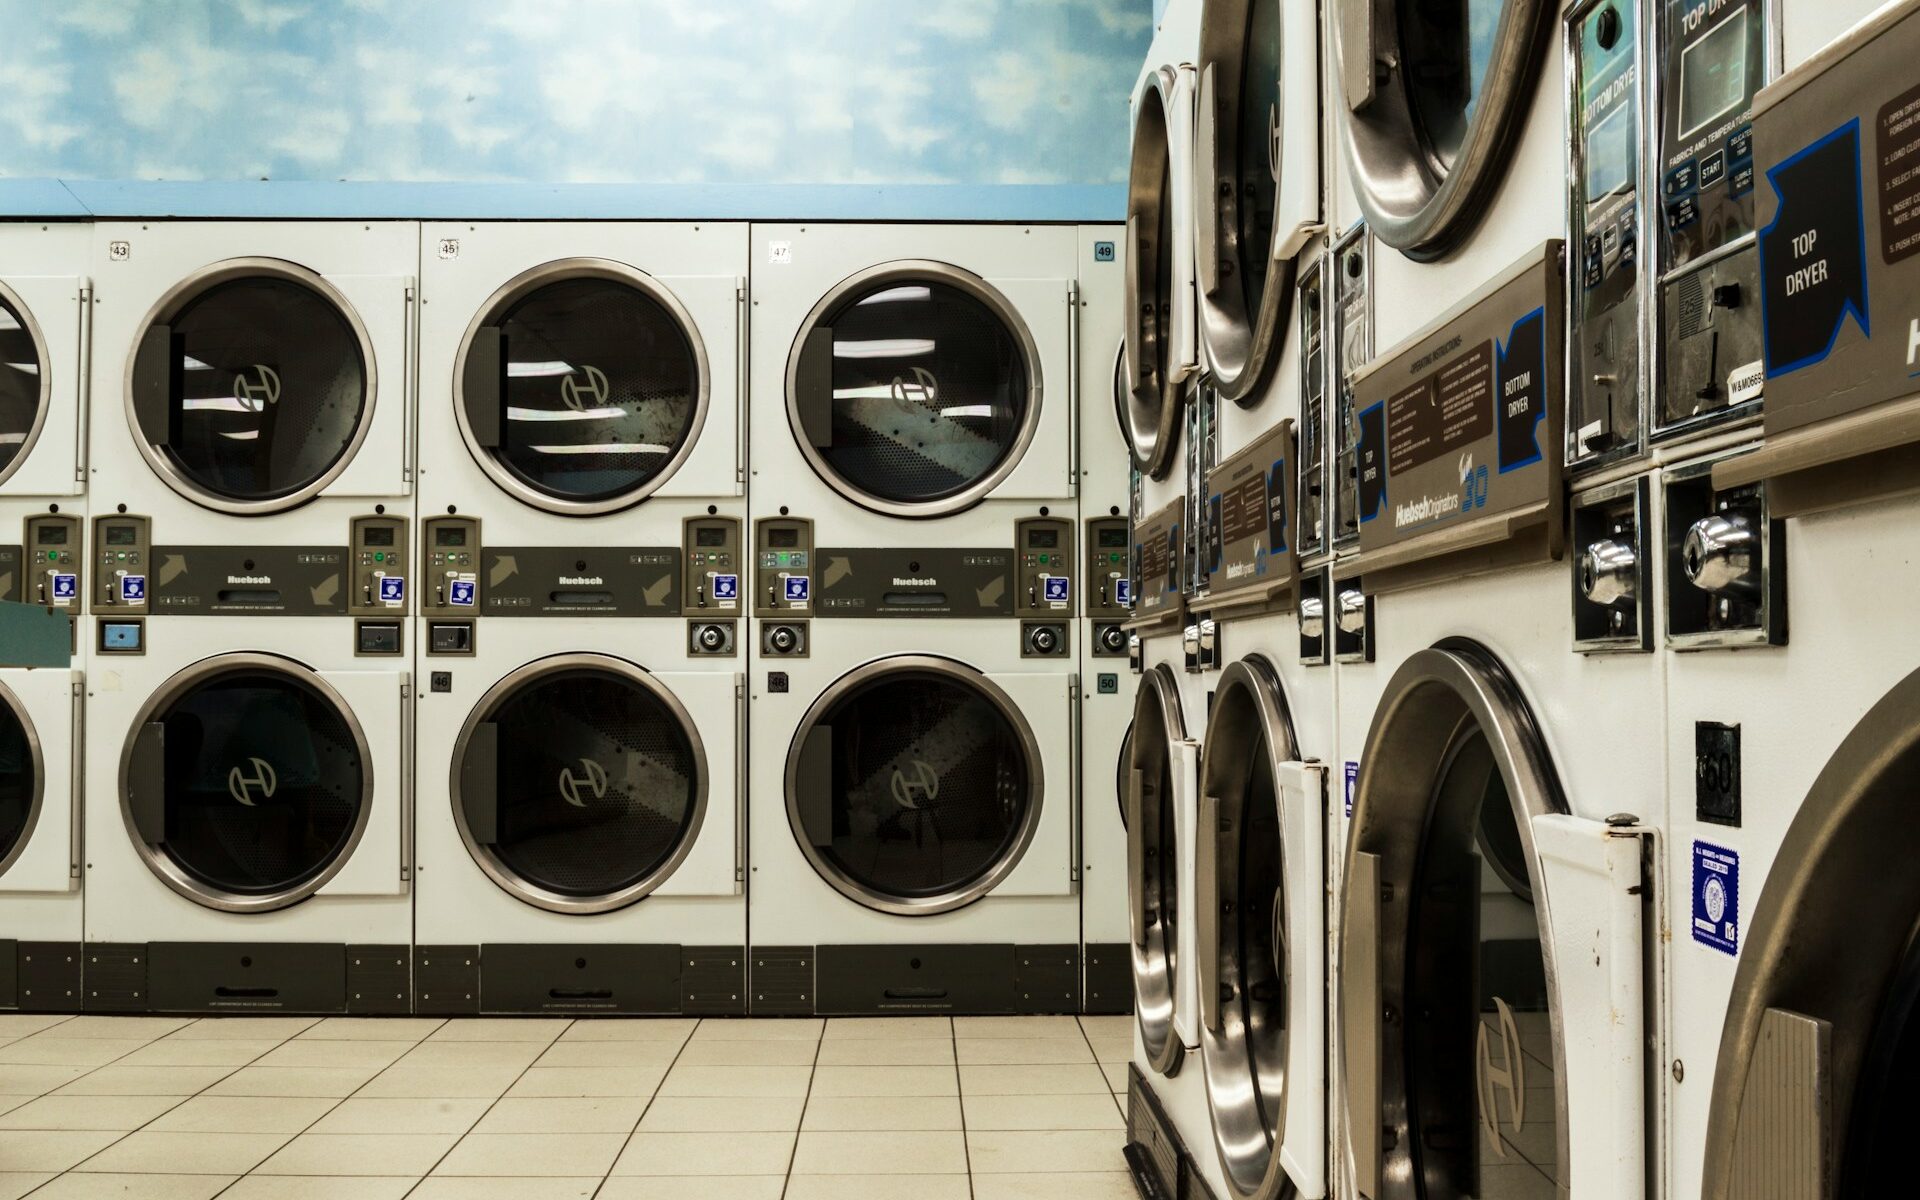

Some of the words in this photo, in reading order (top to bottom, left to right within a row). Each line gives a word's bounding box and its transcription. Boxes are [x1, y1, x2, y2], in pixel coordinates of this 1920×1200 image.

[1682, 2, 1706, 35] TOP
[1613, 64, 1635, 98] DRYE
[1889, 109, 1904, 124] OPEN
[1889, 117, 1913, 137] FOREIGN
[1669, 145, 1694, 168] FABRICS
[1694, 137, 1708, 153] AND
[1890, 147, 1906, 162] LOAD
[1702, 160, 1721, 180] START
[1891, 171, 1911, 188] SELECT
[1893, 196, 1912, 213] INSERT
[113, 246, 126, 256] 43
[442, 244, 455, 254] 45
[1098, 246, 1111, 256] 49
[1792, 229, 1817, 259] TOP
[1895, 238, 1911, 251] PUSH
[773, 247, 786, 257] 47
[1786, 259, 1828, 297] DRYER
[1505, 370, 1531, 397] BOTTOM
[1508, 396, 1529, 419] DRYER
[1365, 450, 1373, 464] TOP
[1363, 466, 1377, 483] DRYER
[227, 575, 271, 584] Huebsch
[558, 576, 603, 585] Huebsch
[892, 577, 937, 586] Huebsch
[434, 676, 448, 687] 46
[1101, 678, 1114, 689] 50
